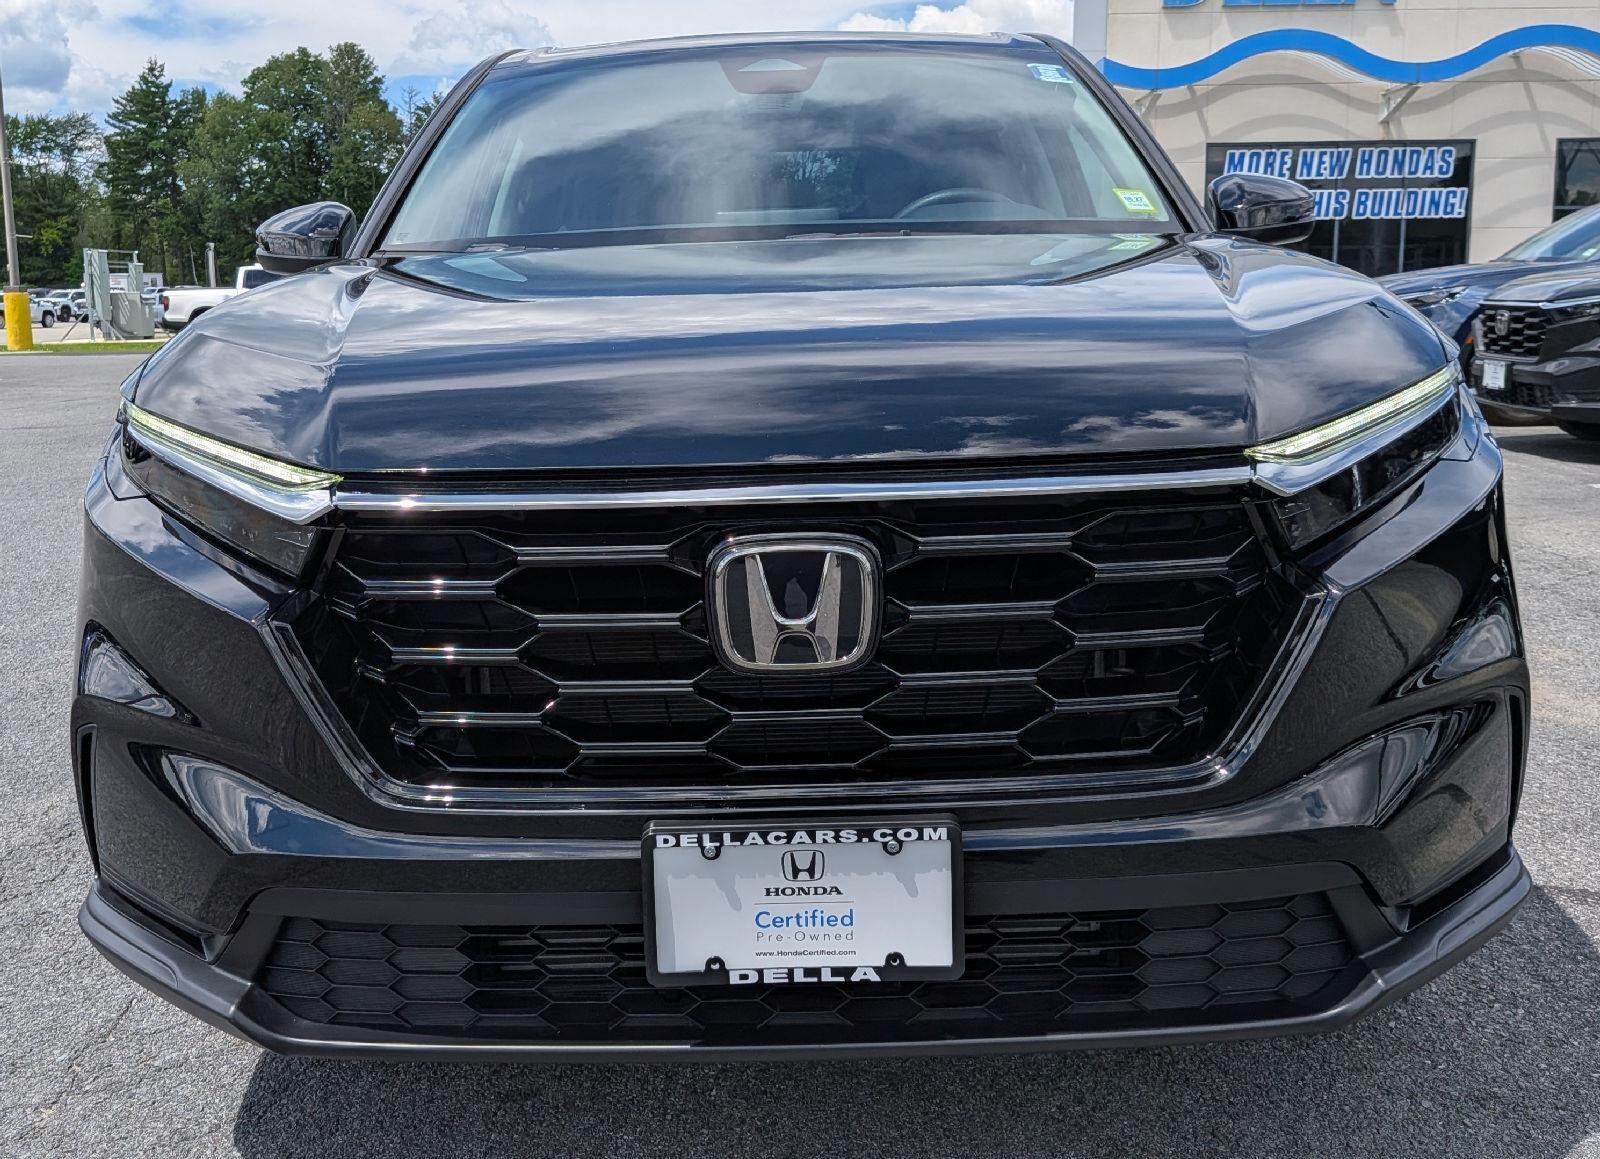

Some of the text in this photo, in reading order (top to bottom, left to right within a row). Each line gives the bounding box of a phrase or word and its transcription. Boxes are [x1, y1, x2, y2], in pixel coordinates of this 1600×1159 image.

[1224, 147, 1455, 179] MORE NEW HONDAS
[1352, 187, 1468, 219] BUILDING!
[656, 827, 948, 848] DELLACARS.COM
[764, 886, 843, 896] HONDA
[755, 908, 854, 928] Certified
[756, 930, 854, 942] Pre-Owned
[755, 949, 857, 957] www.HondaCertified.com
[729, 967, 881, 984] DELLA
